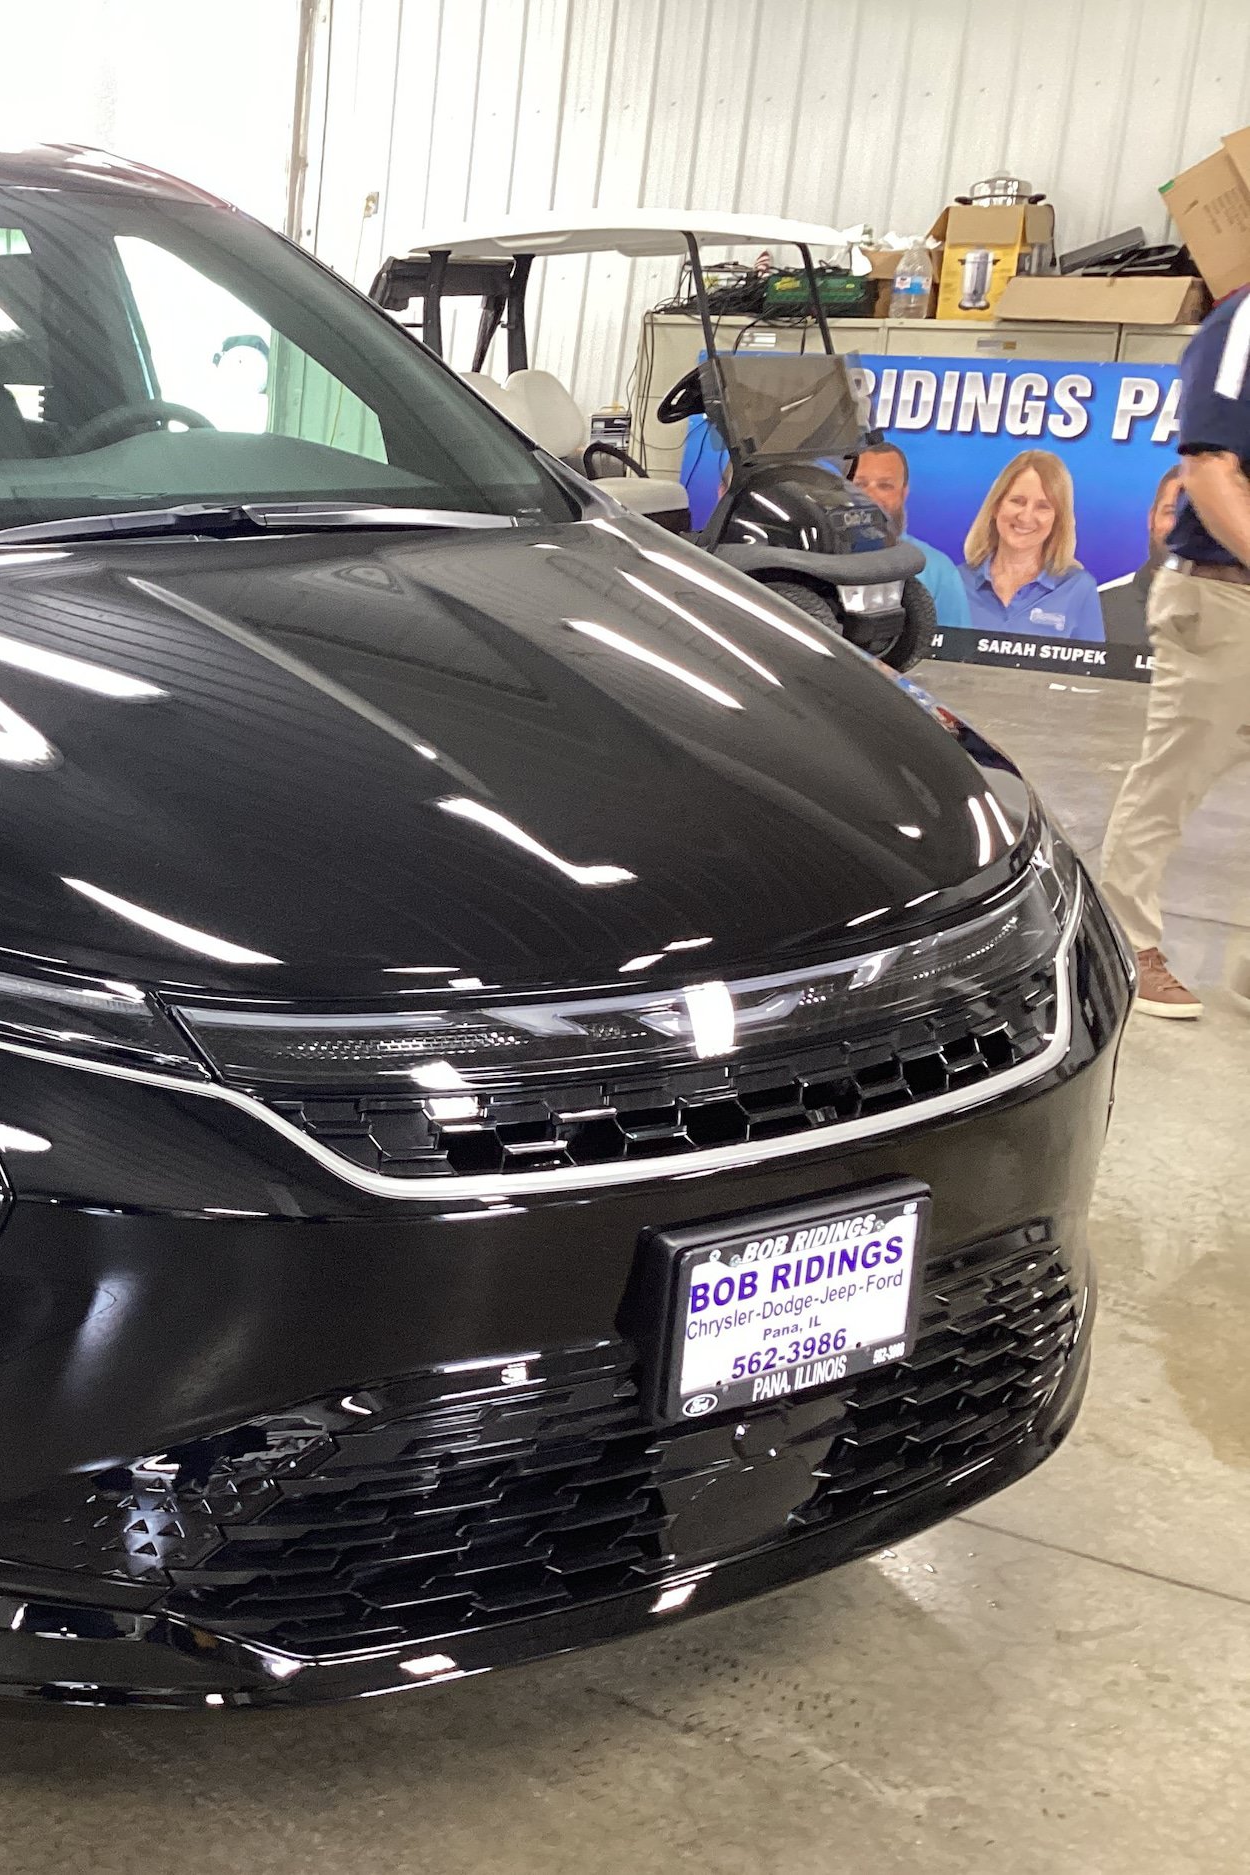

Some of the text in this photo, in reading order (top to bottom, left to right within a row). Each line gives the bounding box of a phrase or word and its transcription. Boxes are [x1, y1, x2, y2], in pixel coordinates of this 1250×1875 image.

[848, 367, 1182, 442] RIDINGS PA
[977, 638, 1107, 665] SARAH STUPEK
[742, 1213, 877, 1263] BOB RIDINGS
[690, 1235, 904, 1315] BOB RIDINGS
[762, 1315, 822, 1341] Pana, IL
[731, 1327, 848, 1380] 562-3986
[793, 1354, 848, 1391] ILLINOIS
